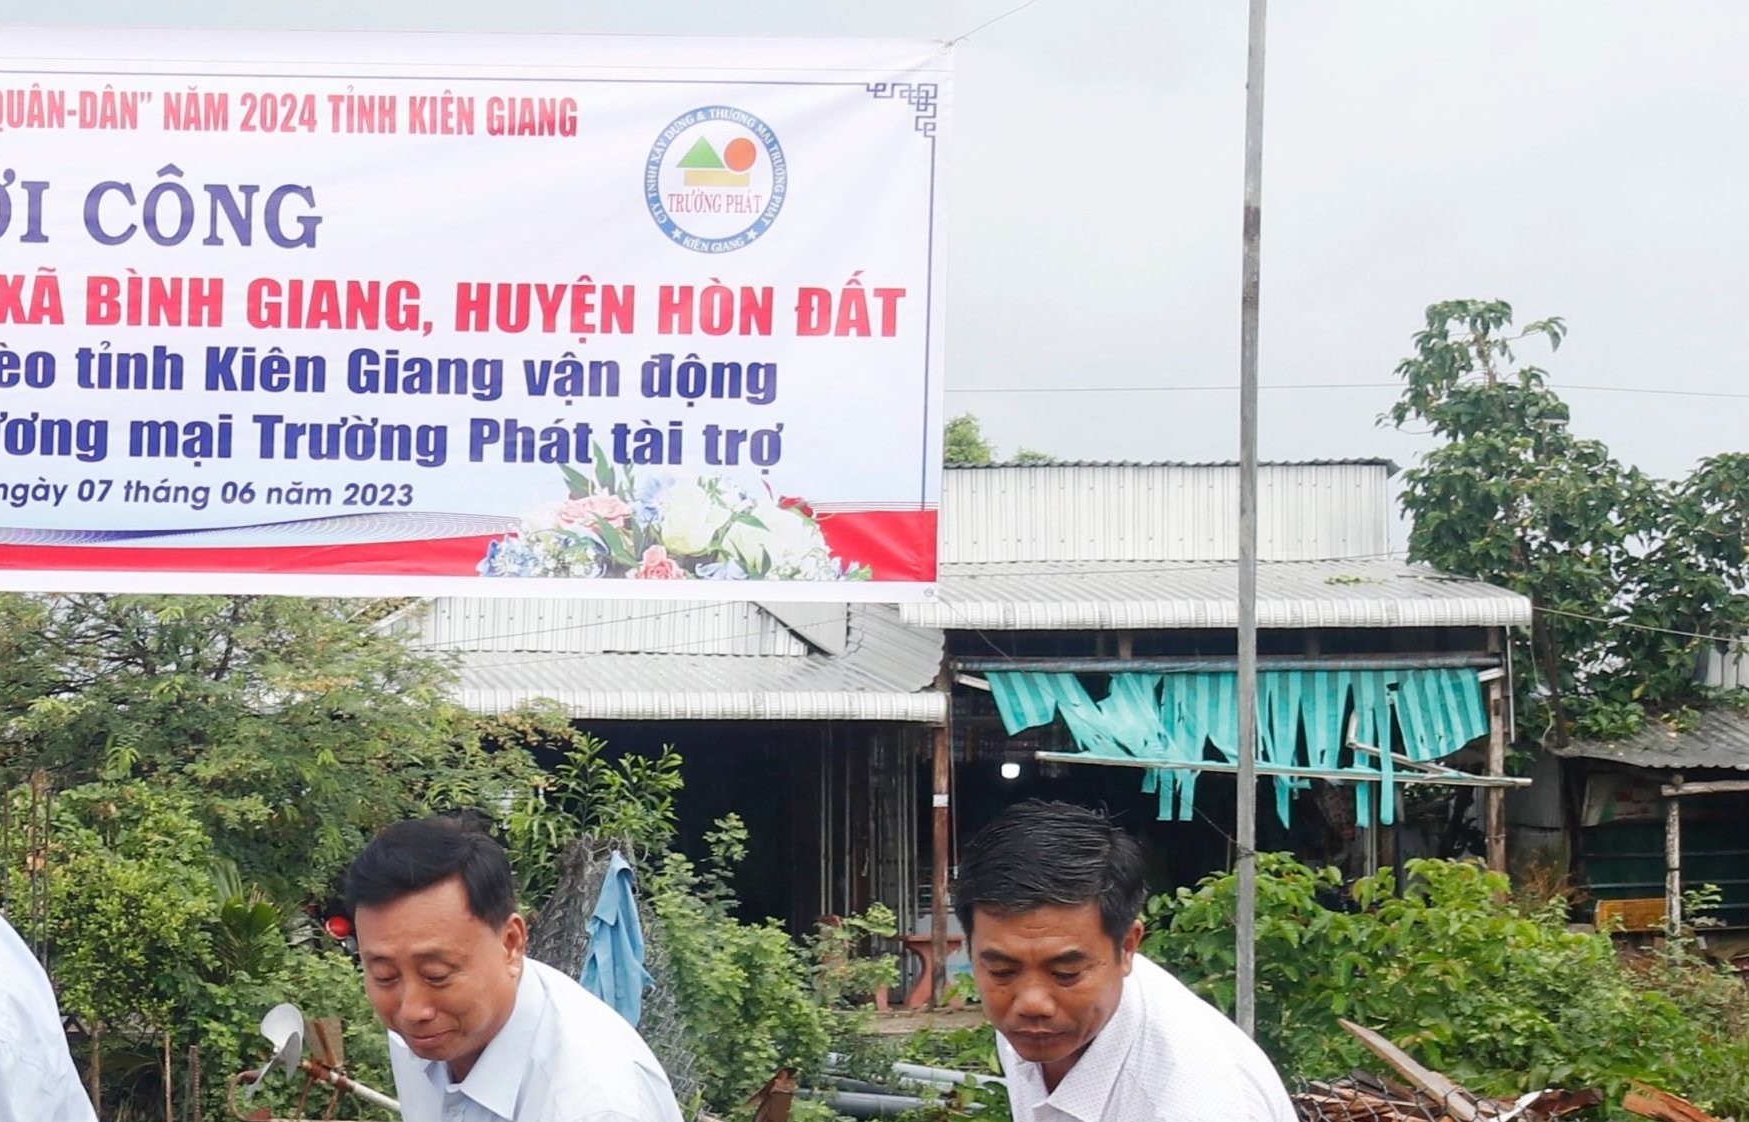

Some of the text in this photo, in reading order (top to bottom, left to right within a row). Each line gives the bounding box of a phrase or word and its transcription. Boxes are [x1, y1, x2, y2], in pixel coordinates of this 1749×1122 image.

[164, 86, 228, 131] NĂM
[240, 92, 317, 133] 2024
[328, 84, 396, 134] TỈNH
[409, 89, 474, 135] KIÊN
[487, 96, 577, 137] GIANG
[83, 163, 323, 249] CÔNG
[668, 189, 762, 214] TRƯỜNG PHÁT
[683, 238, 745, 252] KIÊN GIANG
[85, 268, 224, 328] BÌNH
[246, 277, 433, 336] GIANG,
[455, 274, 635, 343] HUYỆN
[658, 277, 774, 336] HÒN
[794, 270, 906, 337] ĐẤT
[75, 341, 184, 391] tỉnh
[205, 346, 326, 393] Kiên
[347, 348, 503, 402] Giang
[523, 351, 620, 406] vận
[640, 353, 777, 408] động
[129, 414, 233, 467] mại
[252, 414, 448, 468] Trường
[469, 416, 592, 465] Phát
[612, 419, 683, 465] tài
[702, 423, 784, 475] trợ
[77, 479, 113, 502] 07
[123, 478, 211, 510] tháng
[221, 481, 256, 504] 06
[266, 481, 332, 505] năm
[342, 483, 413, 507] 2023
